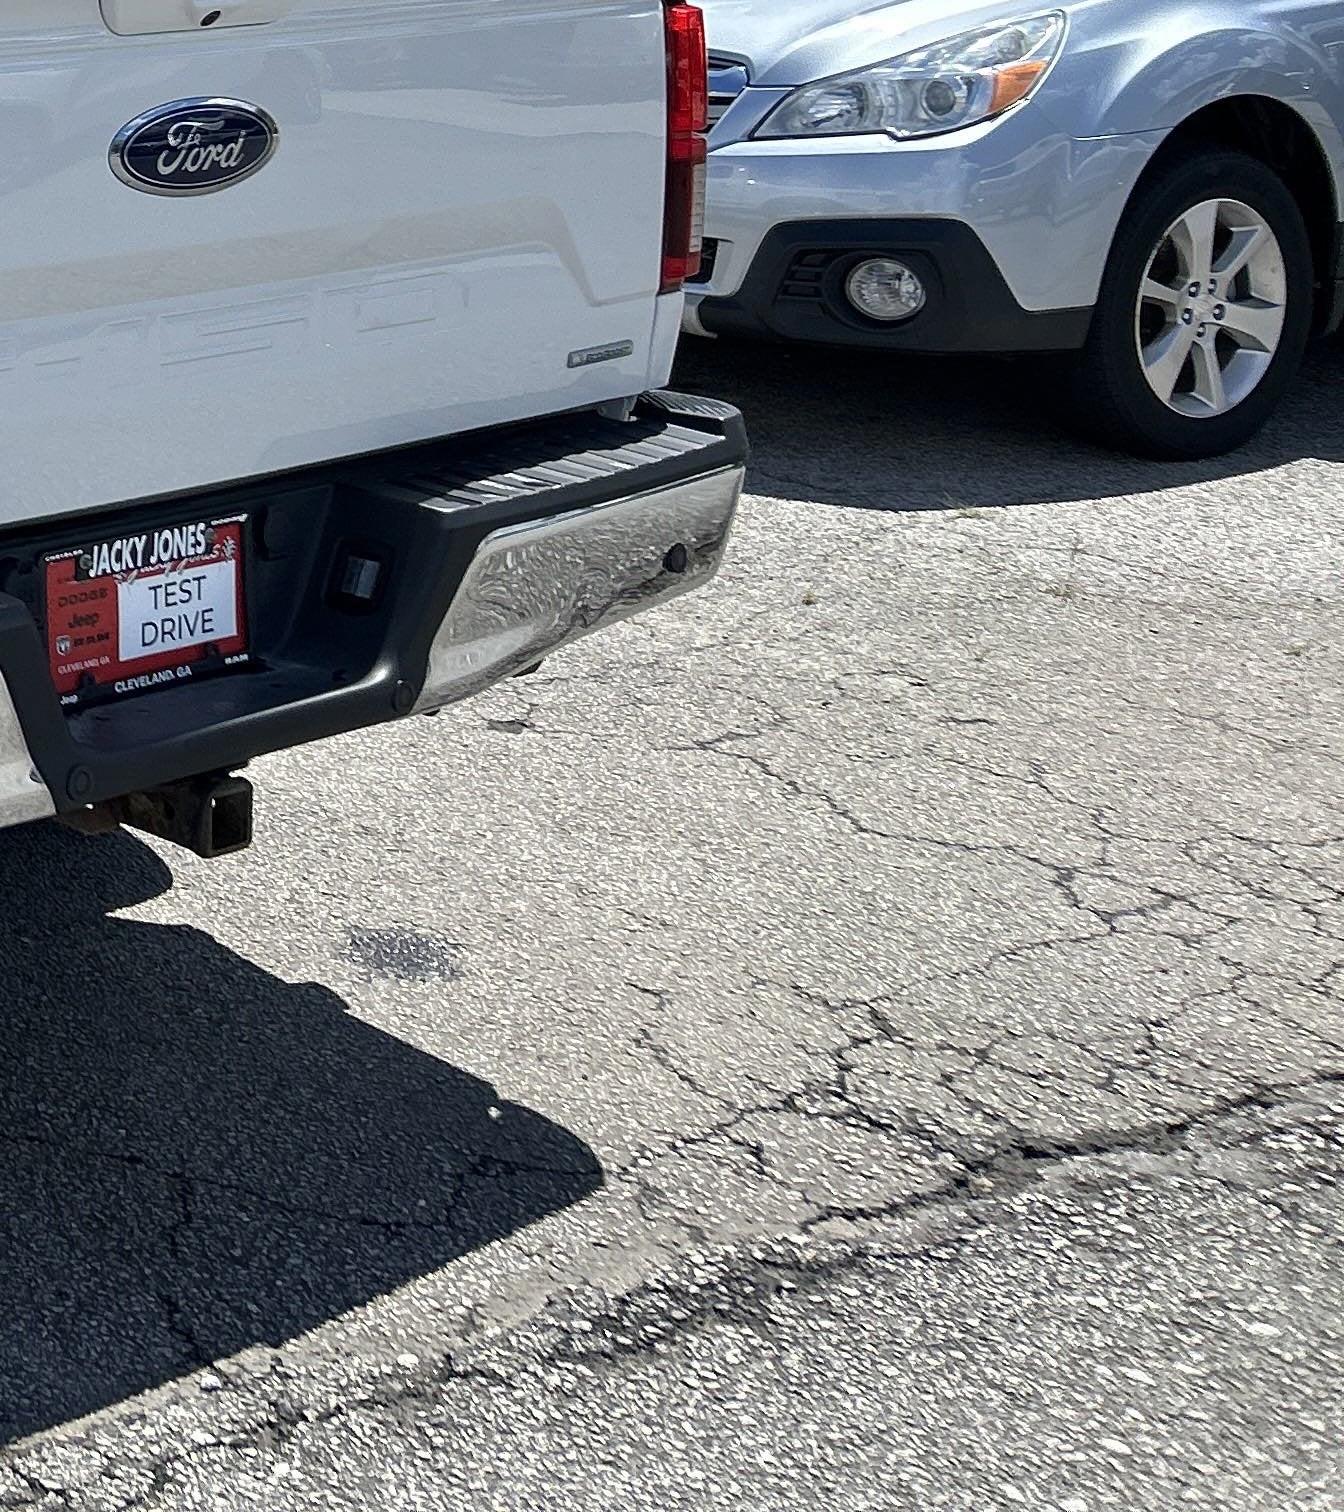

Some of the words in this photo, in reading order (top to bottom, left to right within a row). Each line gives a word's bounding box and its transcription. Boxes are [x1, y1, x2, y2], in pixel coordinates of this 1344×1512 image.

[156, 119, 248, 176] Ford
[88, 534, 148, 578] JACKY
[149, 522, 207, 565] JONES
[57, 588, 109, 608] DODGE
[147, 574, 207, 610] TEST
[67, 611, 101, 629] Jeep
[141, 607, 215, 647] DRIVE
[175, 664, 193, 679] GA
